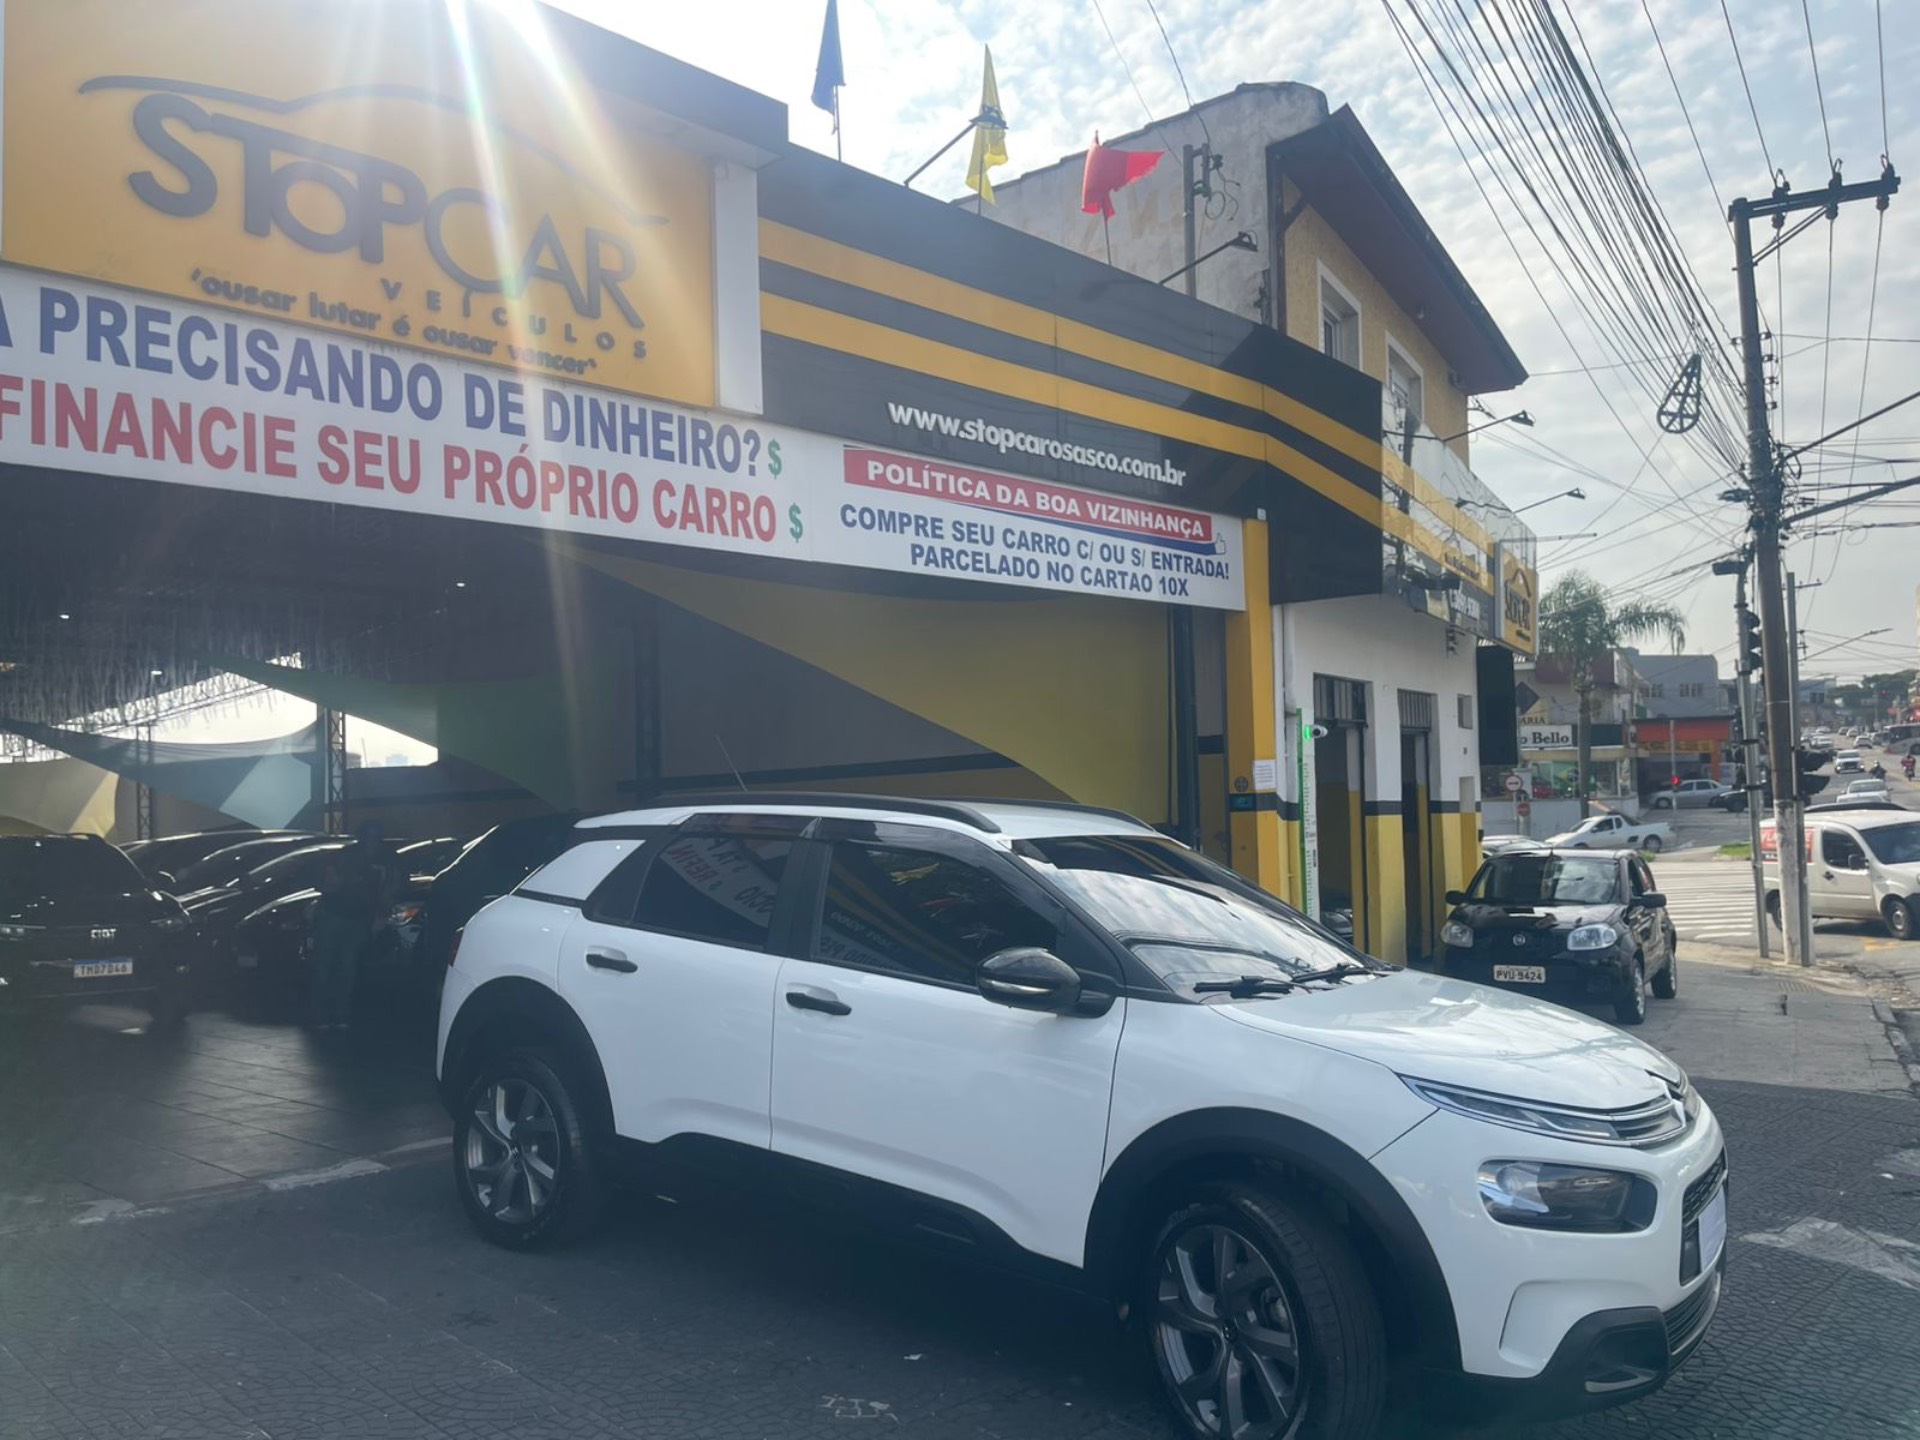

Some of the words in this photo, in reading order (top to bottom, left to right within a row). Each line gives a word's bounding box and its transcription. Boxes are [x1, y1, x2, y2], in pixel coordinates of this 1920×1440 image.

[128, 93, 645, 330] STOPCAR
[309, 291, 381, 331] lutar
[392, 314, 411, 337] é
[423, 325, 498, 355] ousar
[40, 286, 443, 422] PRECISANDO
[464, 373, 526, 437] DE
[542, 388, 761, 477] DINHEIRO?
[0, 374, 297, 478] FINANCIE
[318, 425, 422, 494] SEU
[443, 443, 639, 524] PRÓPRIO
[653, 479, 776, 542] CARRO
[888, 402, 1187, 486] www.stopcarosasco.com.br
[867, 460, 991, 501] POLÍTICA
[996, 484, 1030, 508] DA
[1036, 491, 1081, 517] BOA
[1086, 501, 1204, 539] VIZINHANÇA
[840, 503, 944, 540] COMPRE
[952, 520, 995, 546] SEU
[1002, 528, 1071, 557] CARRO
[1077, 538, 1094, 561] C/
[1099, 543, 1125, 565] OU
[1131, 549, 1146, 568] S/
[1151, 551, 1230, 580] ENTRADA!
[911, 543, 1040, 580] PARCELADO
[1047, 560, 1074, 584] NO
[1159, 576, 1189, 597] 10X
[1532, 731, 1570, 745] Bello
